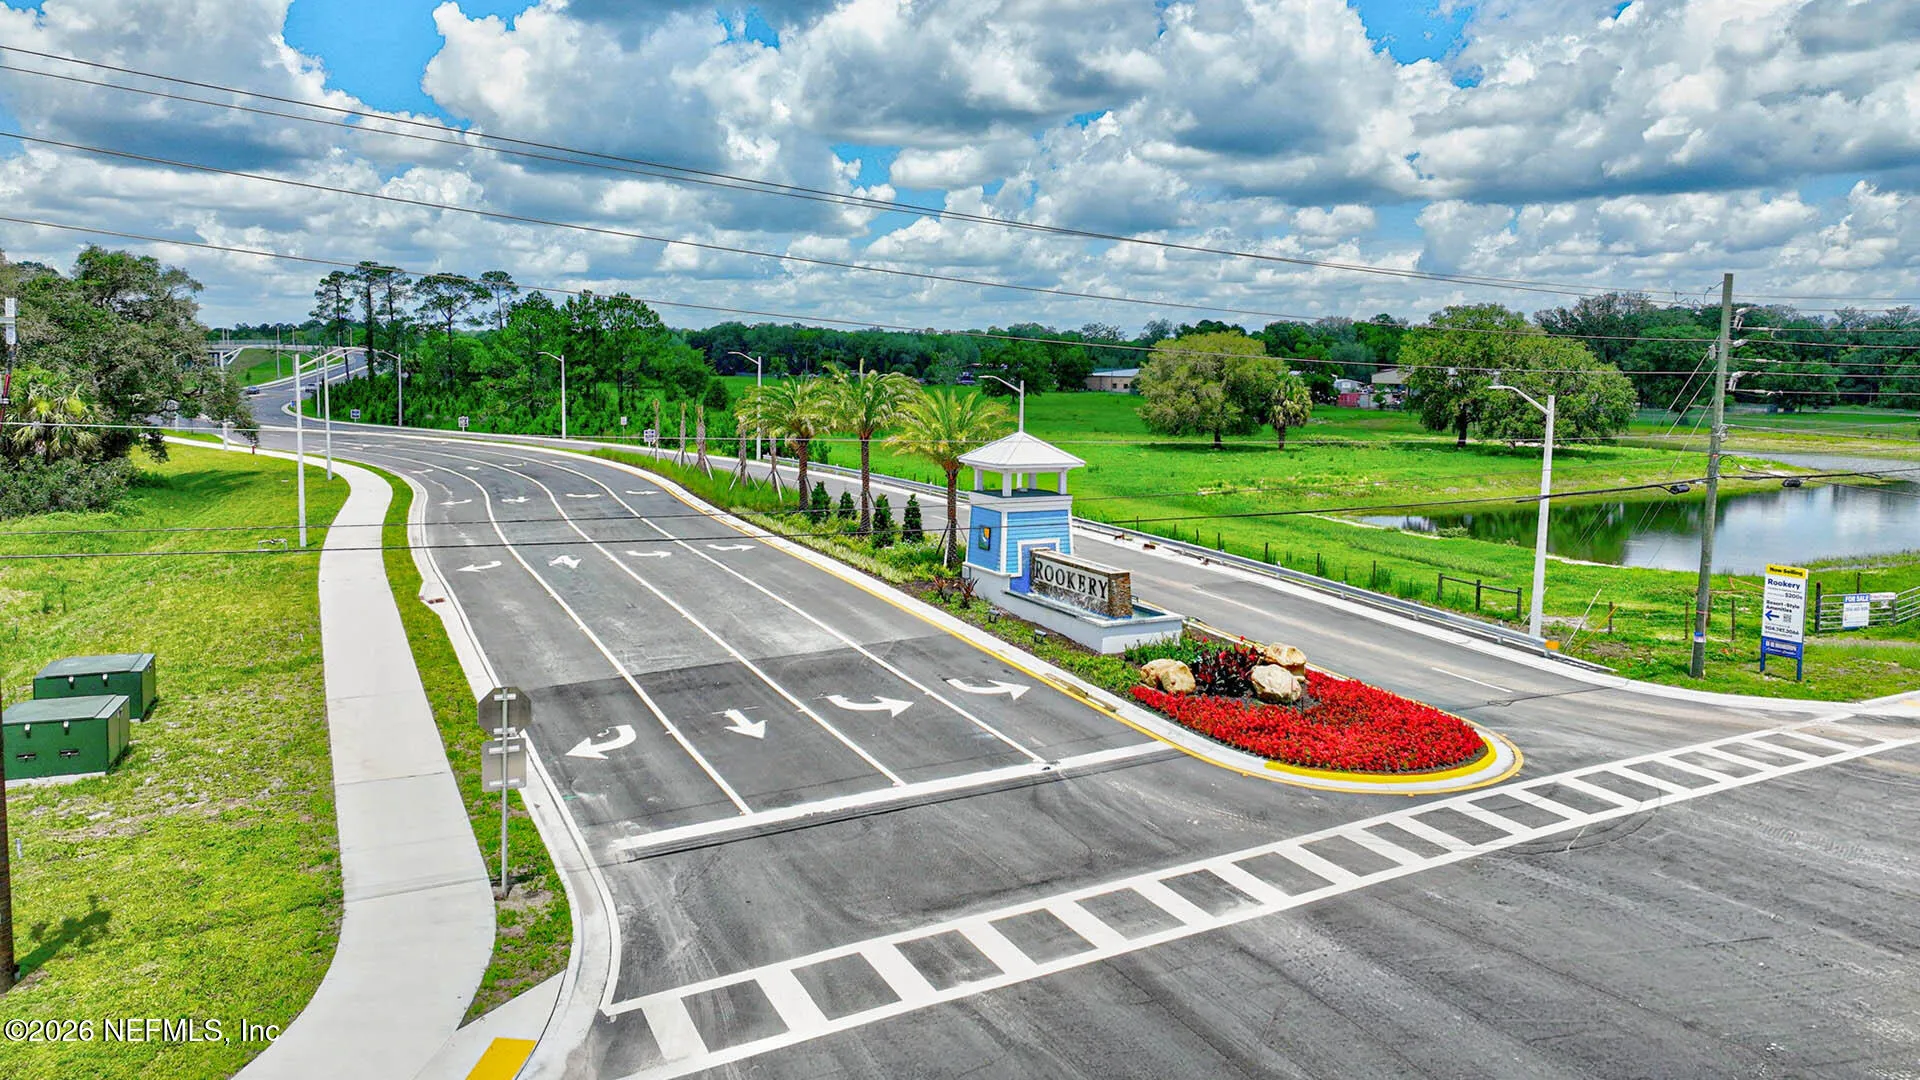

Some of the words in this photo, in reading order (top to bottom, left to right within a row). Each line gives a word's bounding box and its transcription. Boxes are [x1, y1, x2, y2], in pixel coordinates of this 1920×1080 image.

[1783, 568, 1803, 576] Selling
[1035, 560, 1108, 599] ROOKERY
[1767, 578, 1800, 590] Rookery
[1766, 605, 1792, 613] Amenities
